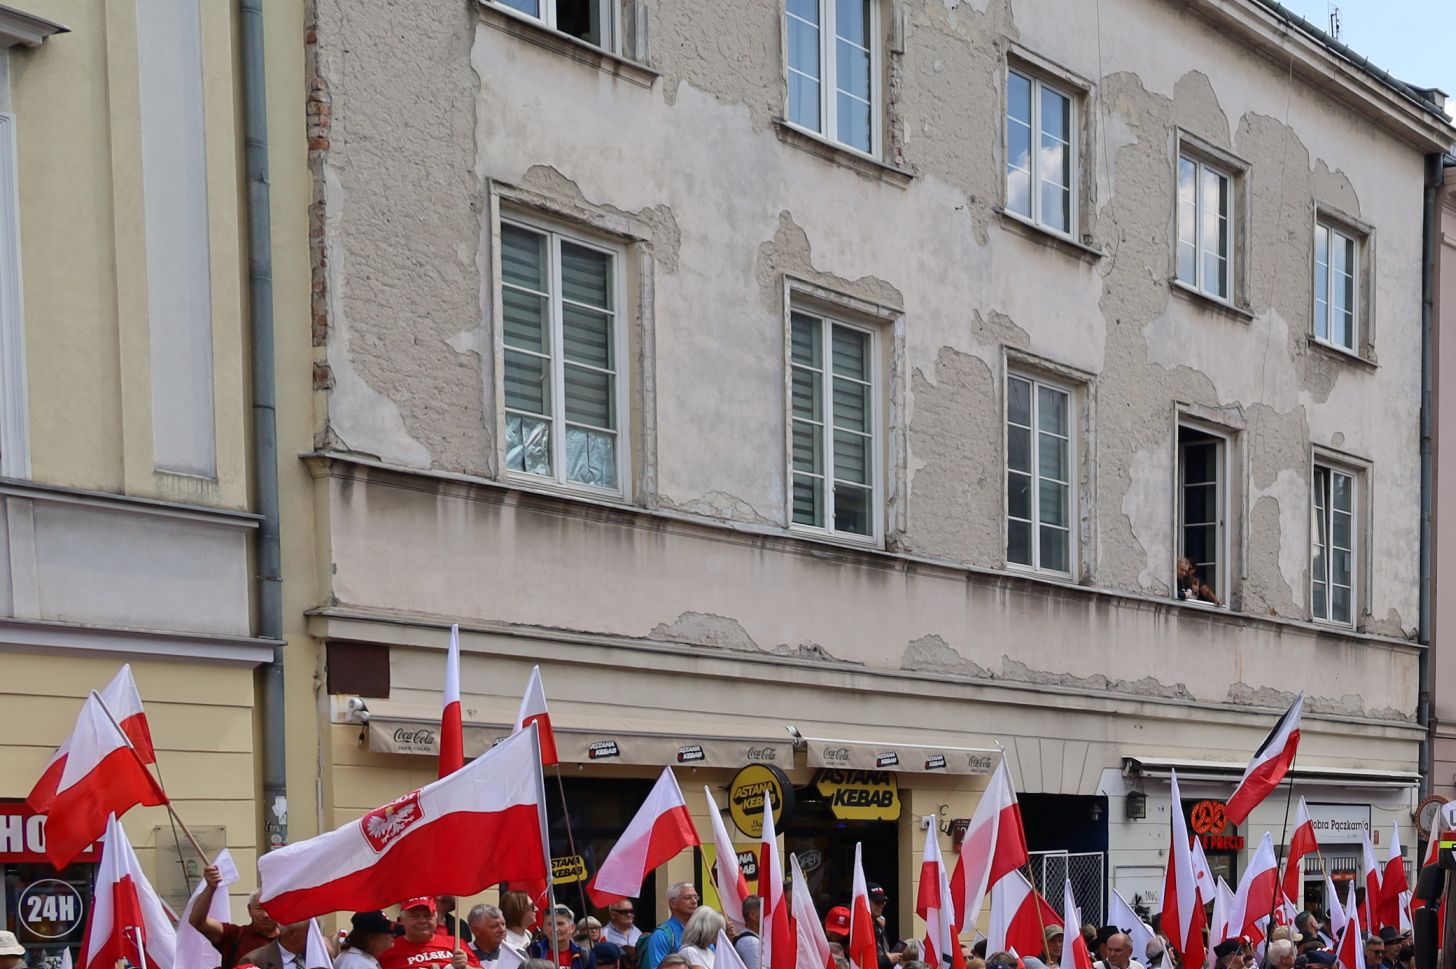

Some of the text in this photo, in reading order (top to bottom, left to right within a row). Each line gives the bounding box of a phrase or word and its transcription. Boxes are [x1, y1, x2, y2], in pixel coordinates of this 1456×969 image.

[735, 781, 773, 798] ASTANA
[833, 788, 894, 807] KEBAB
[742, 794, 776, 810] KEBB
[551, 857, 580, 868] STANA
[27, 896, 75, 922] 24H
[407, 951, 453, 965] POLSKA
